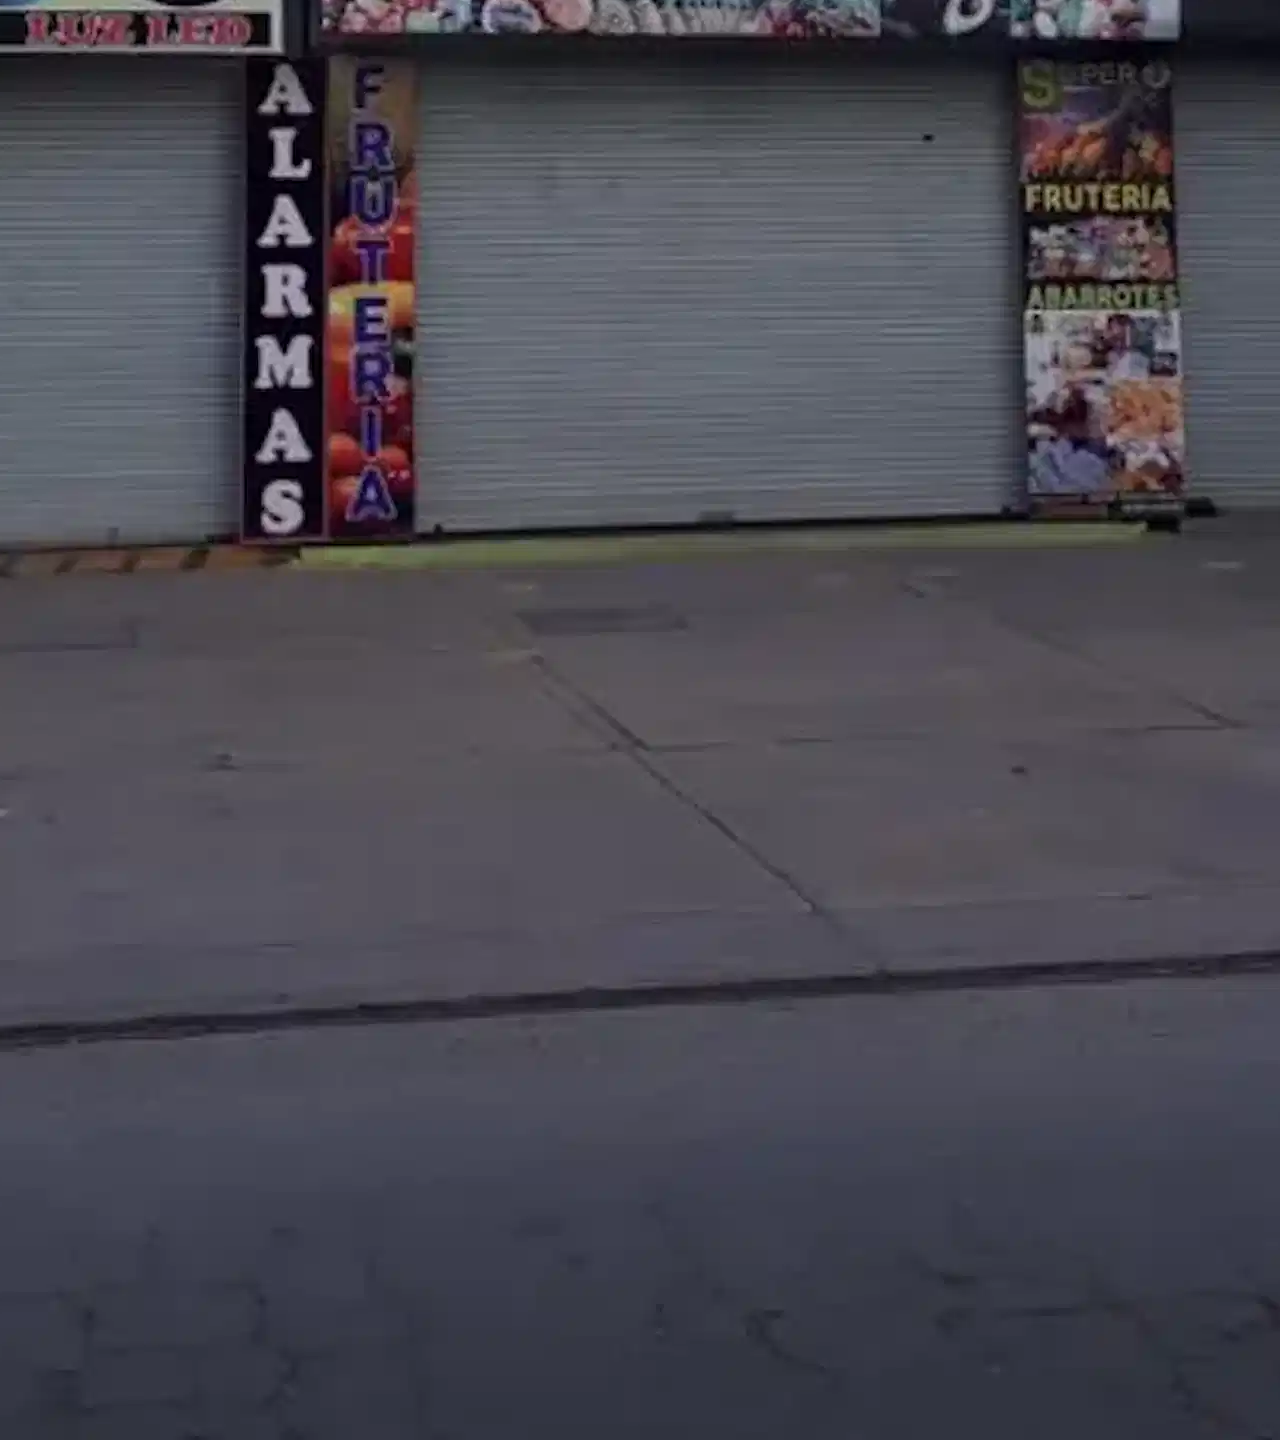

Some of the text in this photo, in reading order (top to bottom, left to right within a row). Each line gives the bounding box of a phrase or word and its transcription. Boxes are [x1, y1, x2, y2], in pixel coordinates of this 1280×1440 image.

[23, 10, 134, 46] LUZ
[143, 13, 253, 48] LED
[1025, 182, 1173, 213] FRUTERIA
[254, 62, 315, 536] ALARMAS
[345, 63, 398, 523] FRUTERIA
[1025, 283, 1181, 311] ABARROTES
